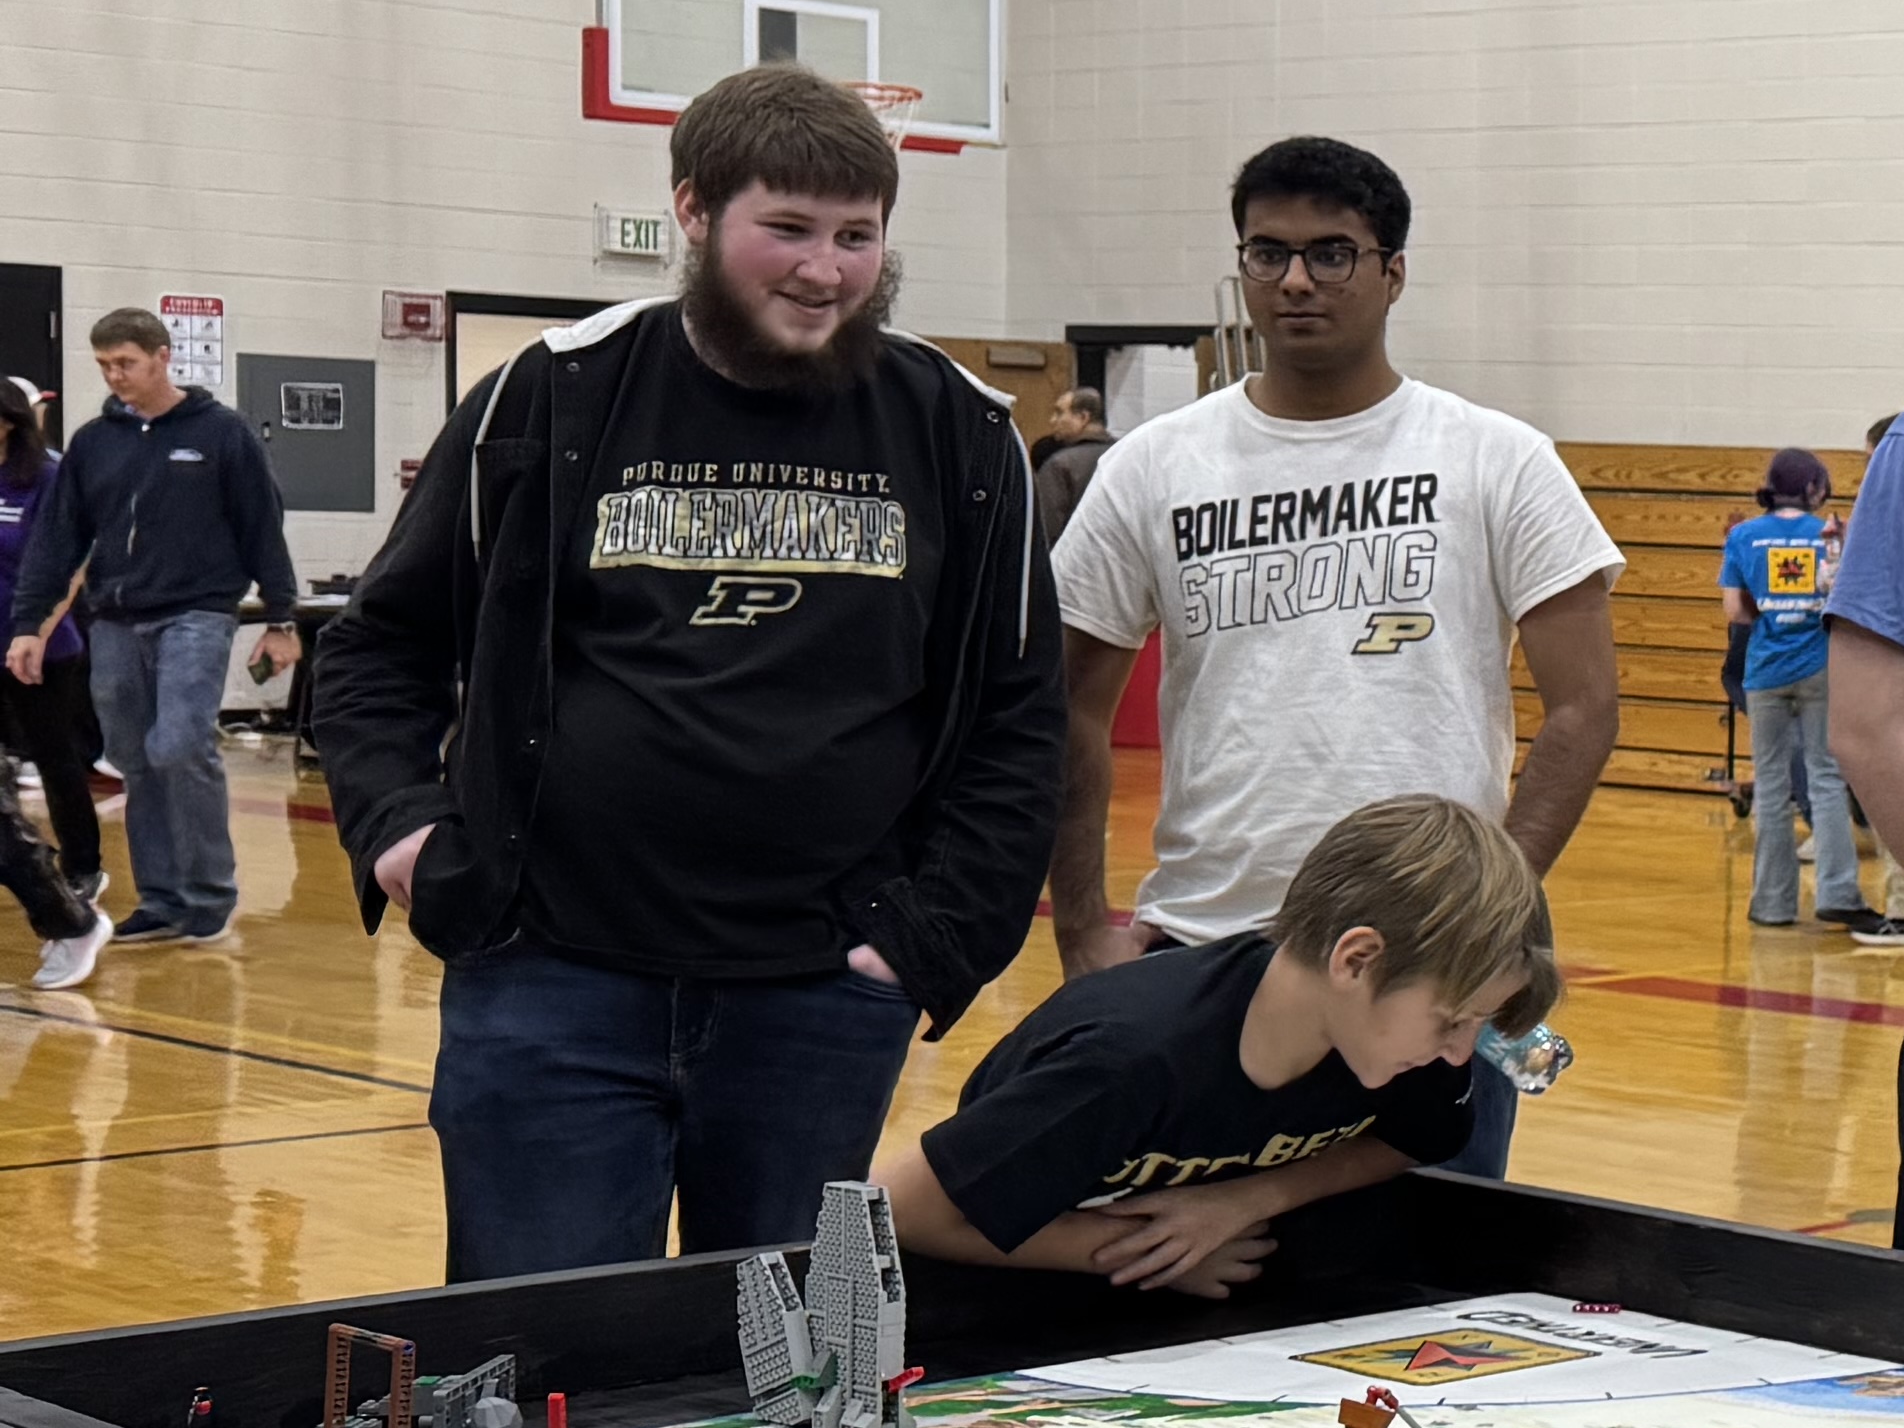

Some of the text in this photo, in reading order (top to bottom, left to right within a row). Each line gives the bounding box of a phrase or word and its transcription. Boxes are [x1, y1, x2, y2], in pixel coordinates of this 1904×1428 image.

[620, 217, 661, 251] EXIT
[622, 460, 890, 493] PURDUE UNIVERSITY
[600, 488, 906, 567] BOILERMAKERS
[1172, 473, 1438, 562] BOILERMAKER
[689, 576, 802, 626] P
[1179, 530, 1437, 638] STRONG
[1351, 612, 1435, 655] P
